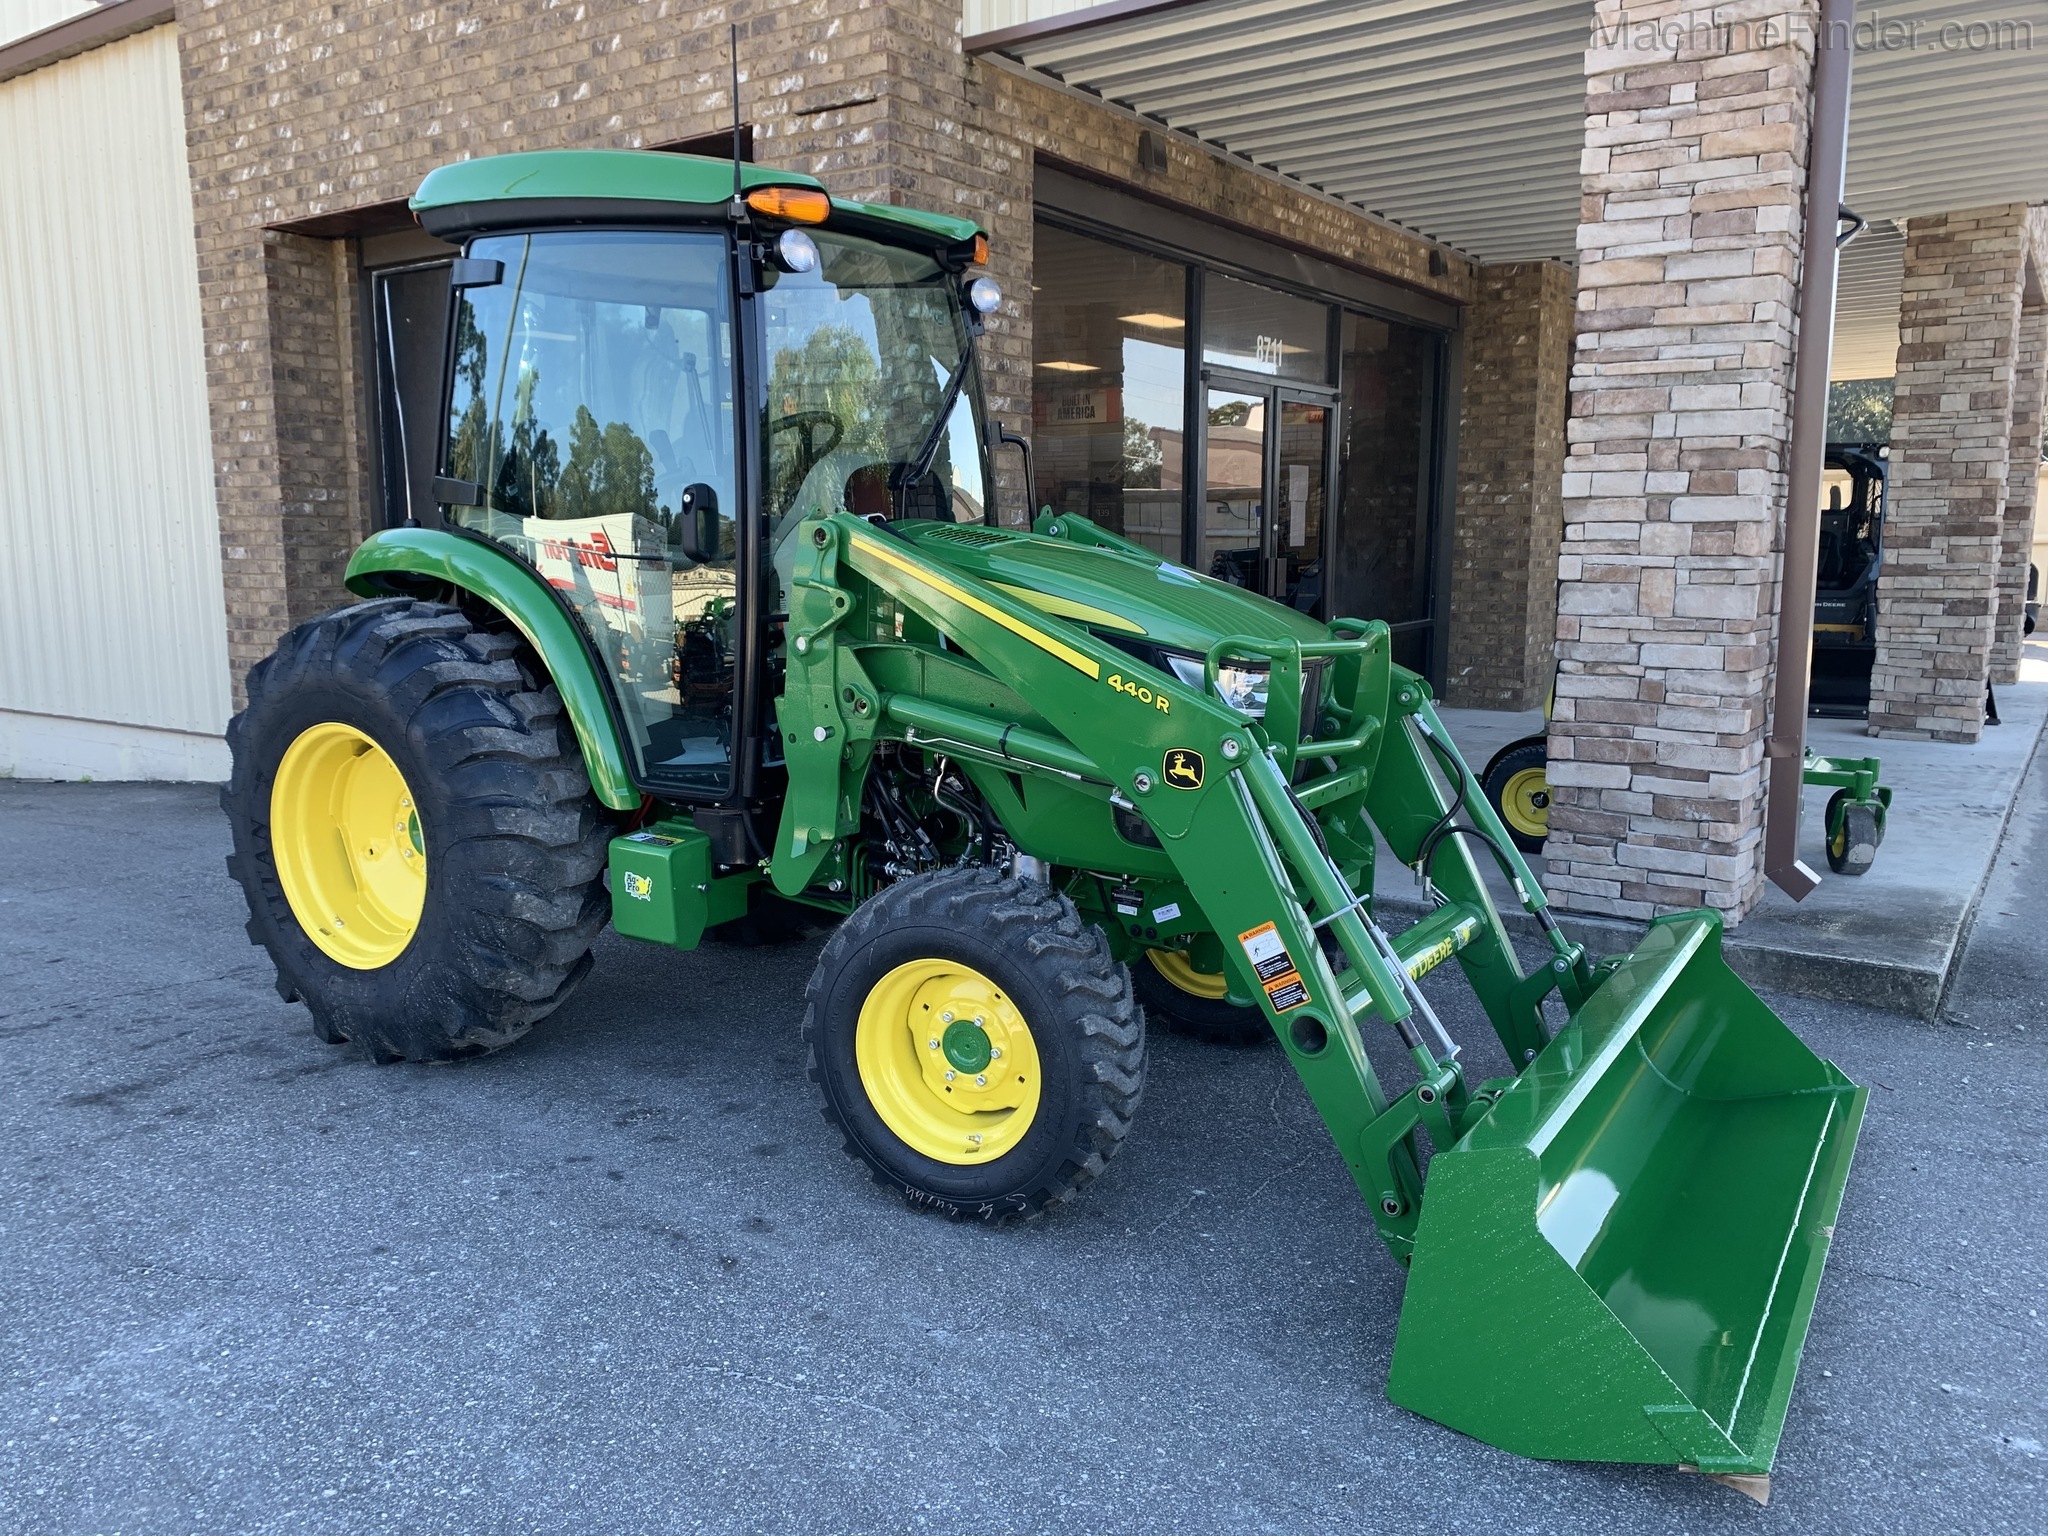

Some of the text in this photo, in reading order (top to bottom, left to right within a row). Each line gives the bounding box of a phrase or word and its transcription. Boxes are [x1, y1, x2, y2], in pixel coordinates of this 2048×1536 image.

[1255, 334, 1284, 367] 8711
[1062, 393, 1091, 407] BUILT IN
[1057, 405, 1096, 421] AMERICA
[1106, 673, 1171, 715] 440 R
[627, 882, 640, 892] Pro
[1248, 924, 1271, 938] WARNING
[1418, 936, 1454, 977] DEERE
[1273, 976, 1297, 988] WARNING
